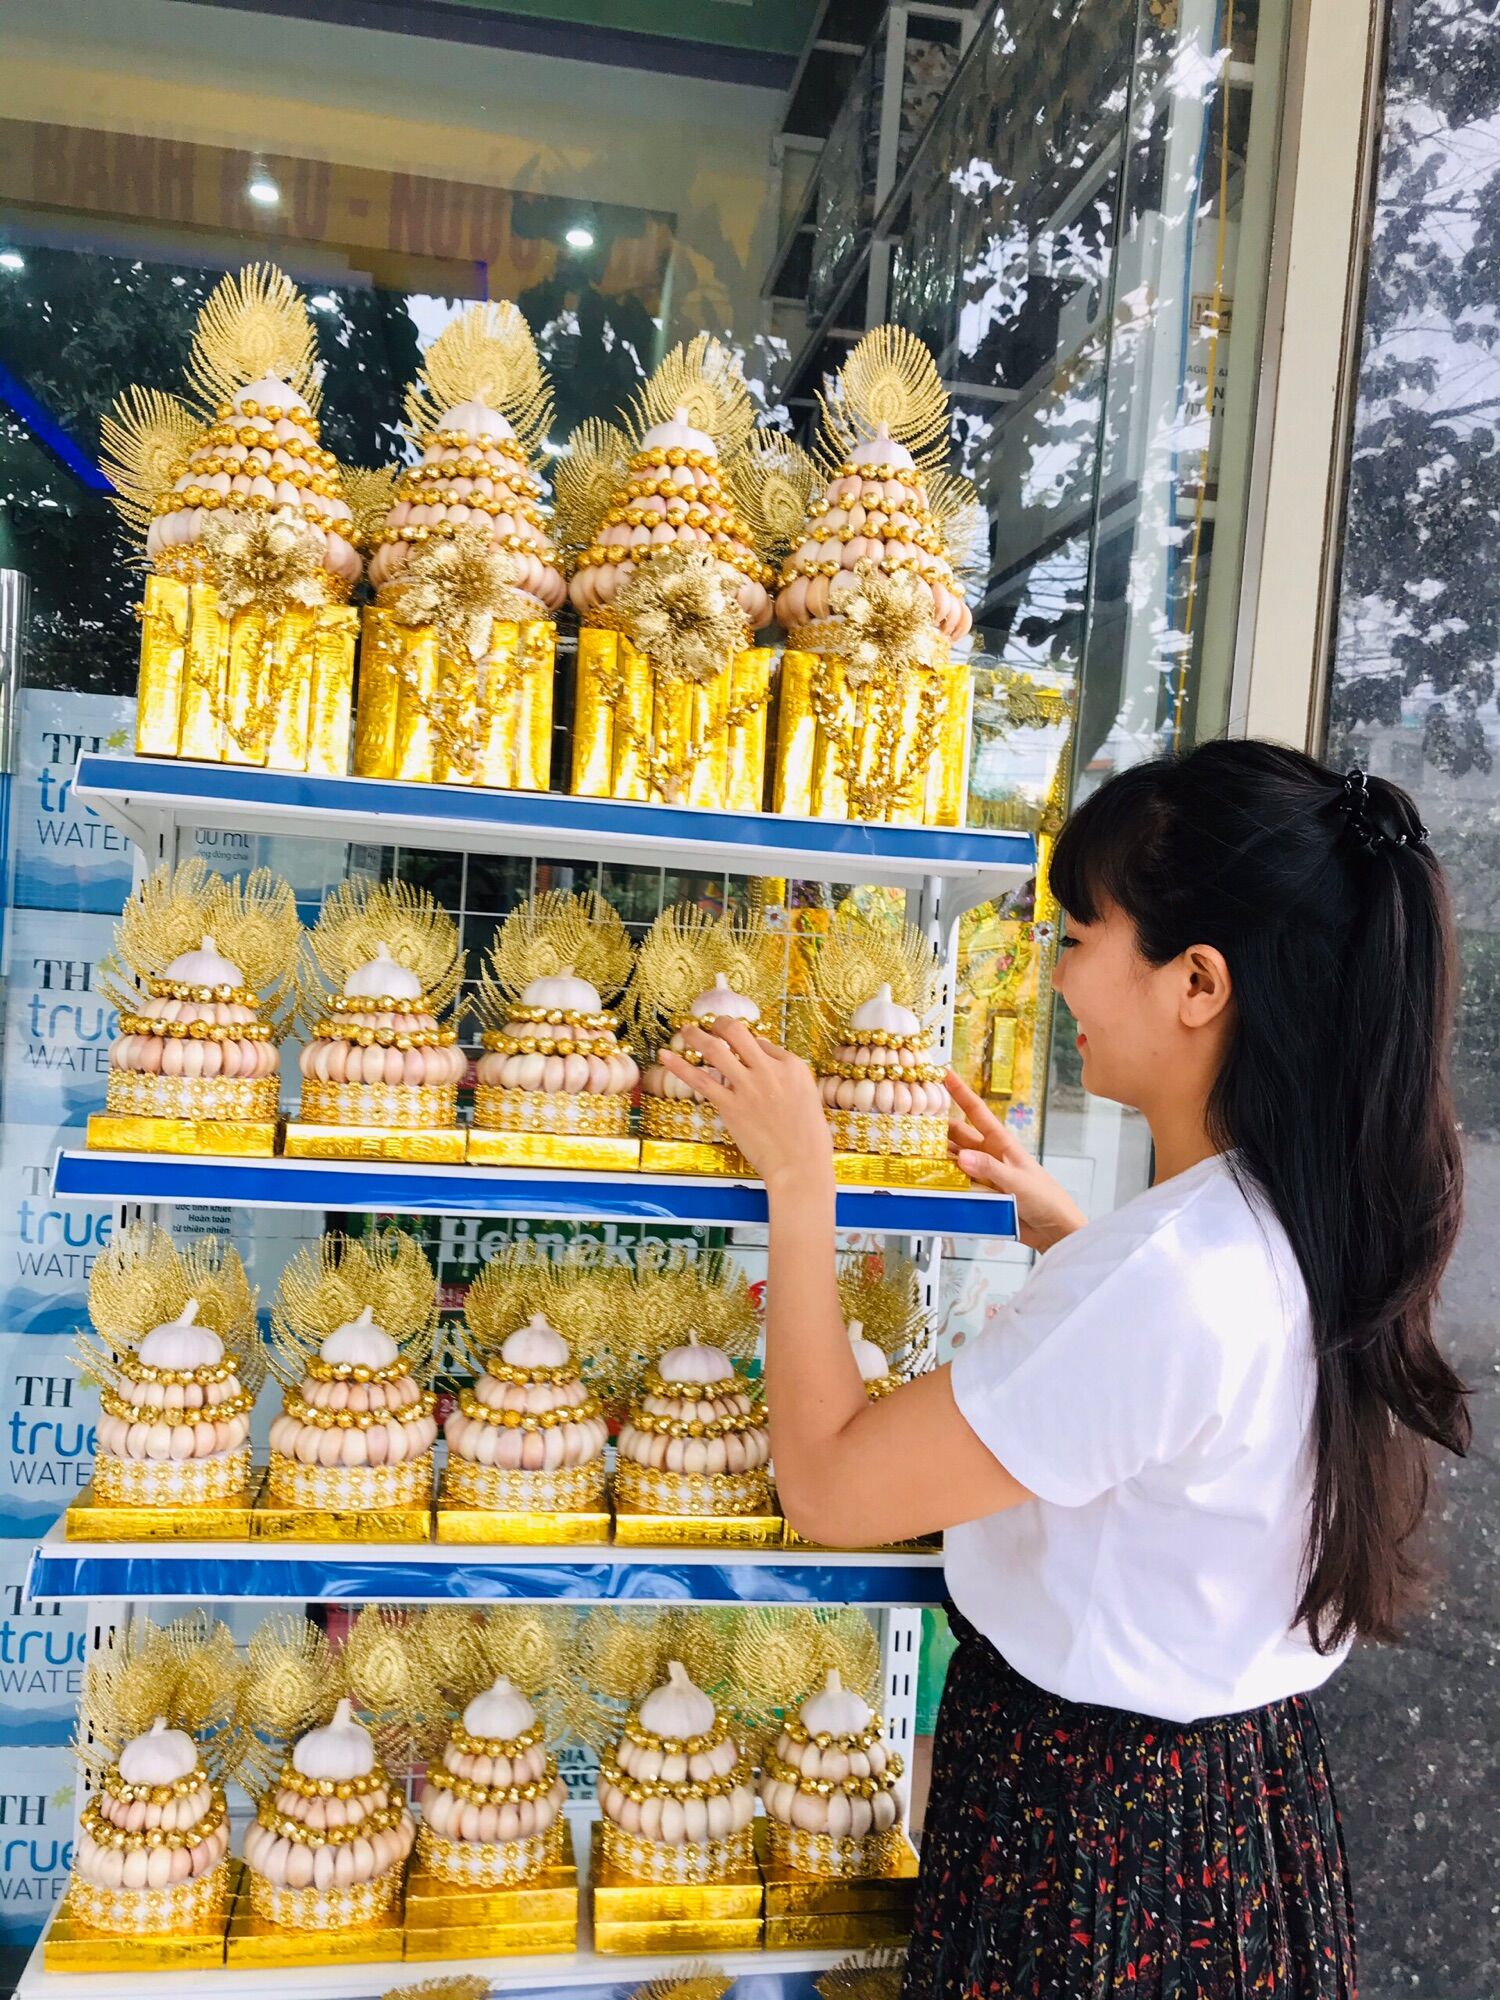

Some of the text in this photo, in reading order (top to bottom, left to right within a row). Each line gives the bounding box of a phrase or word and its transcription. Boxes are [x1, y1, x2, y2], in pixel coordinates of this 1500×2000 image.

[33, 959, 94, 992] TH
[28, 1044, 108, 1073] WATE
[17, 1251, 97, 1279] WATE
[15, 1375, 76, 1408] TH
[10, 1460, 92, 1486] WATE
[0, 1670, 82, 1693] WATE
[0, 1840, 73, 1872] ru
[0, 1878, 66, 1900] ATE
